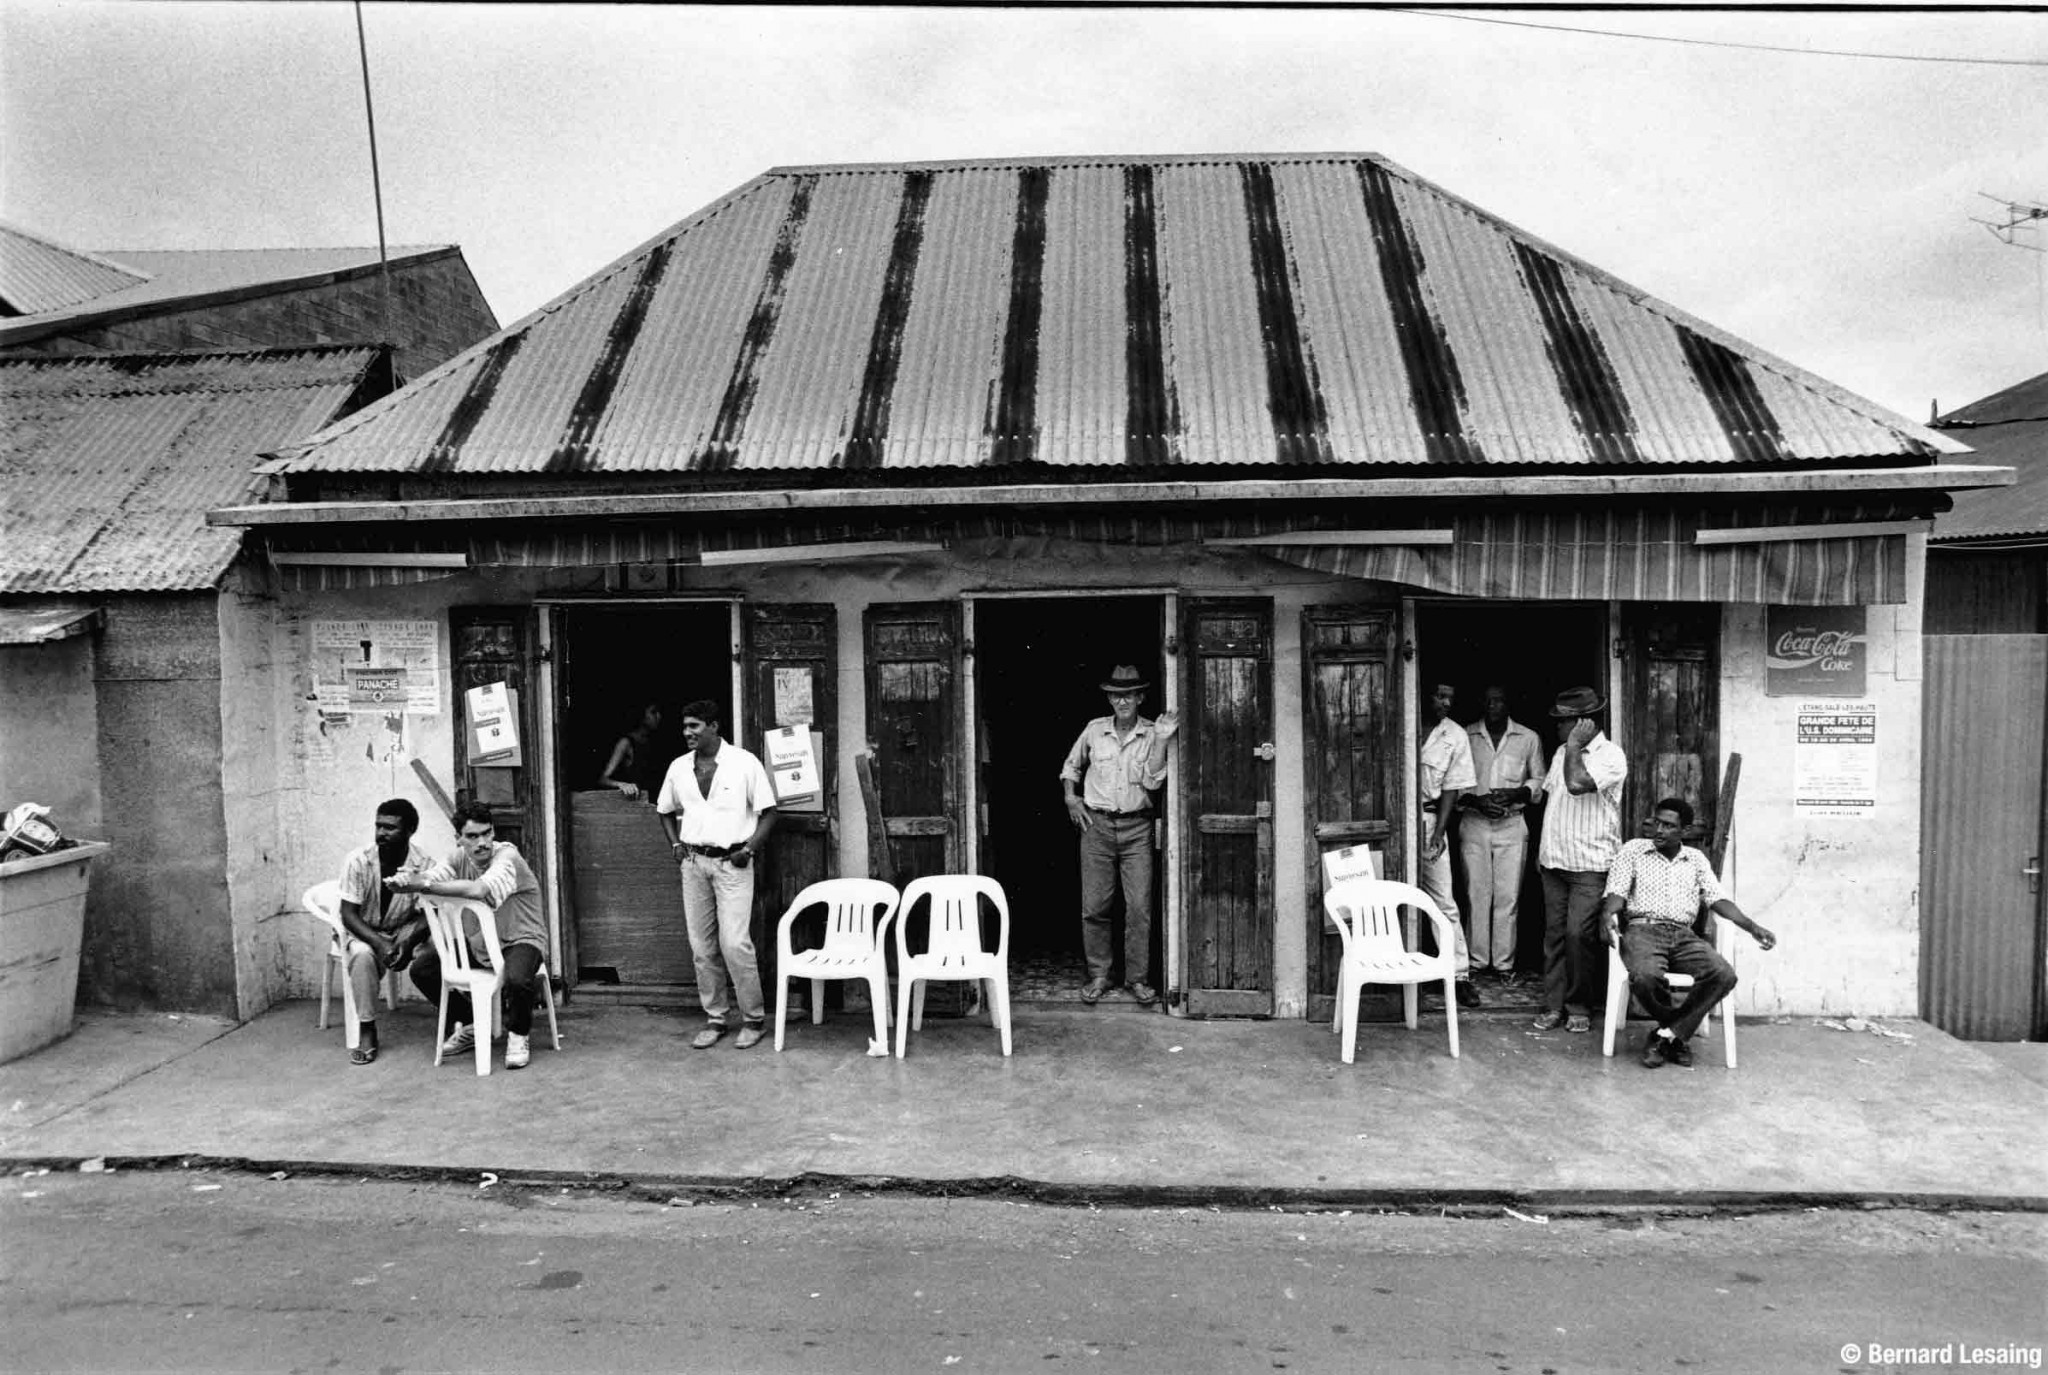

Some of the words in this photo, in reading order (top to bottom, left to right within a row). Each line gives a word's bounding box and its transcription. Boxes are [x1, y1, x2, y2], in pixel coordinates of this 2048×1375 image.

[1820, 657, 1853, 671] Coke
[1799, 716, 1836, 725] GRANDE
[1837, 716, 1860, 725] FETE
[1861, 716, 1874, 725] DE
